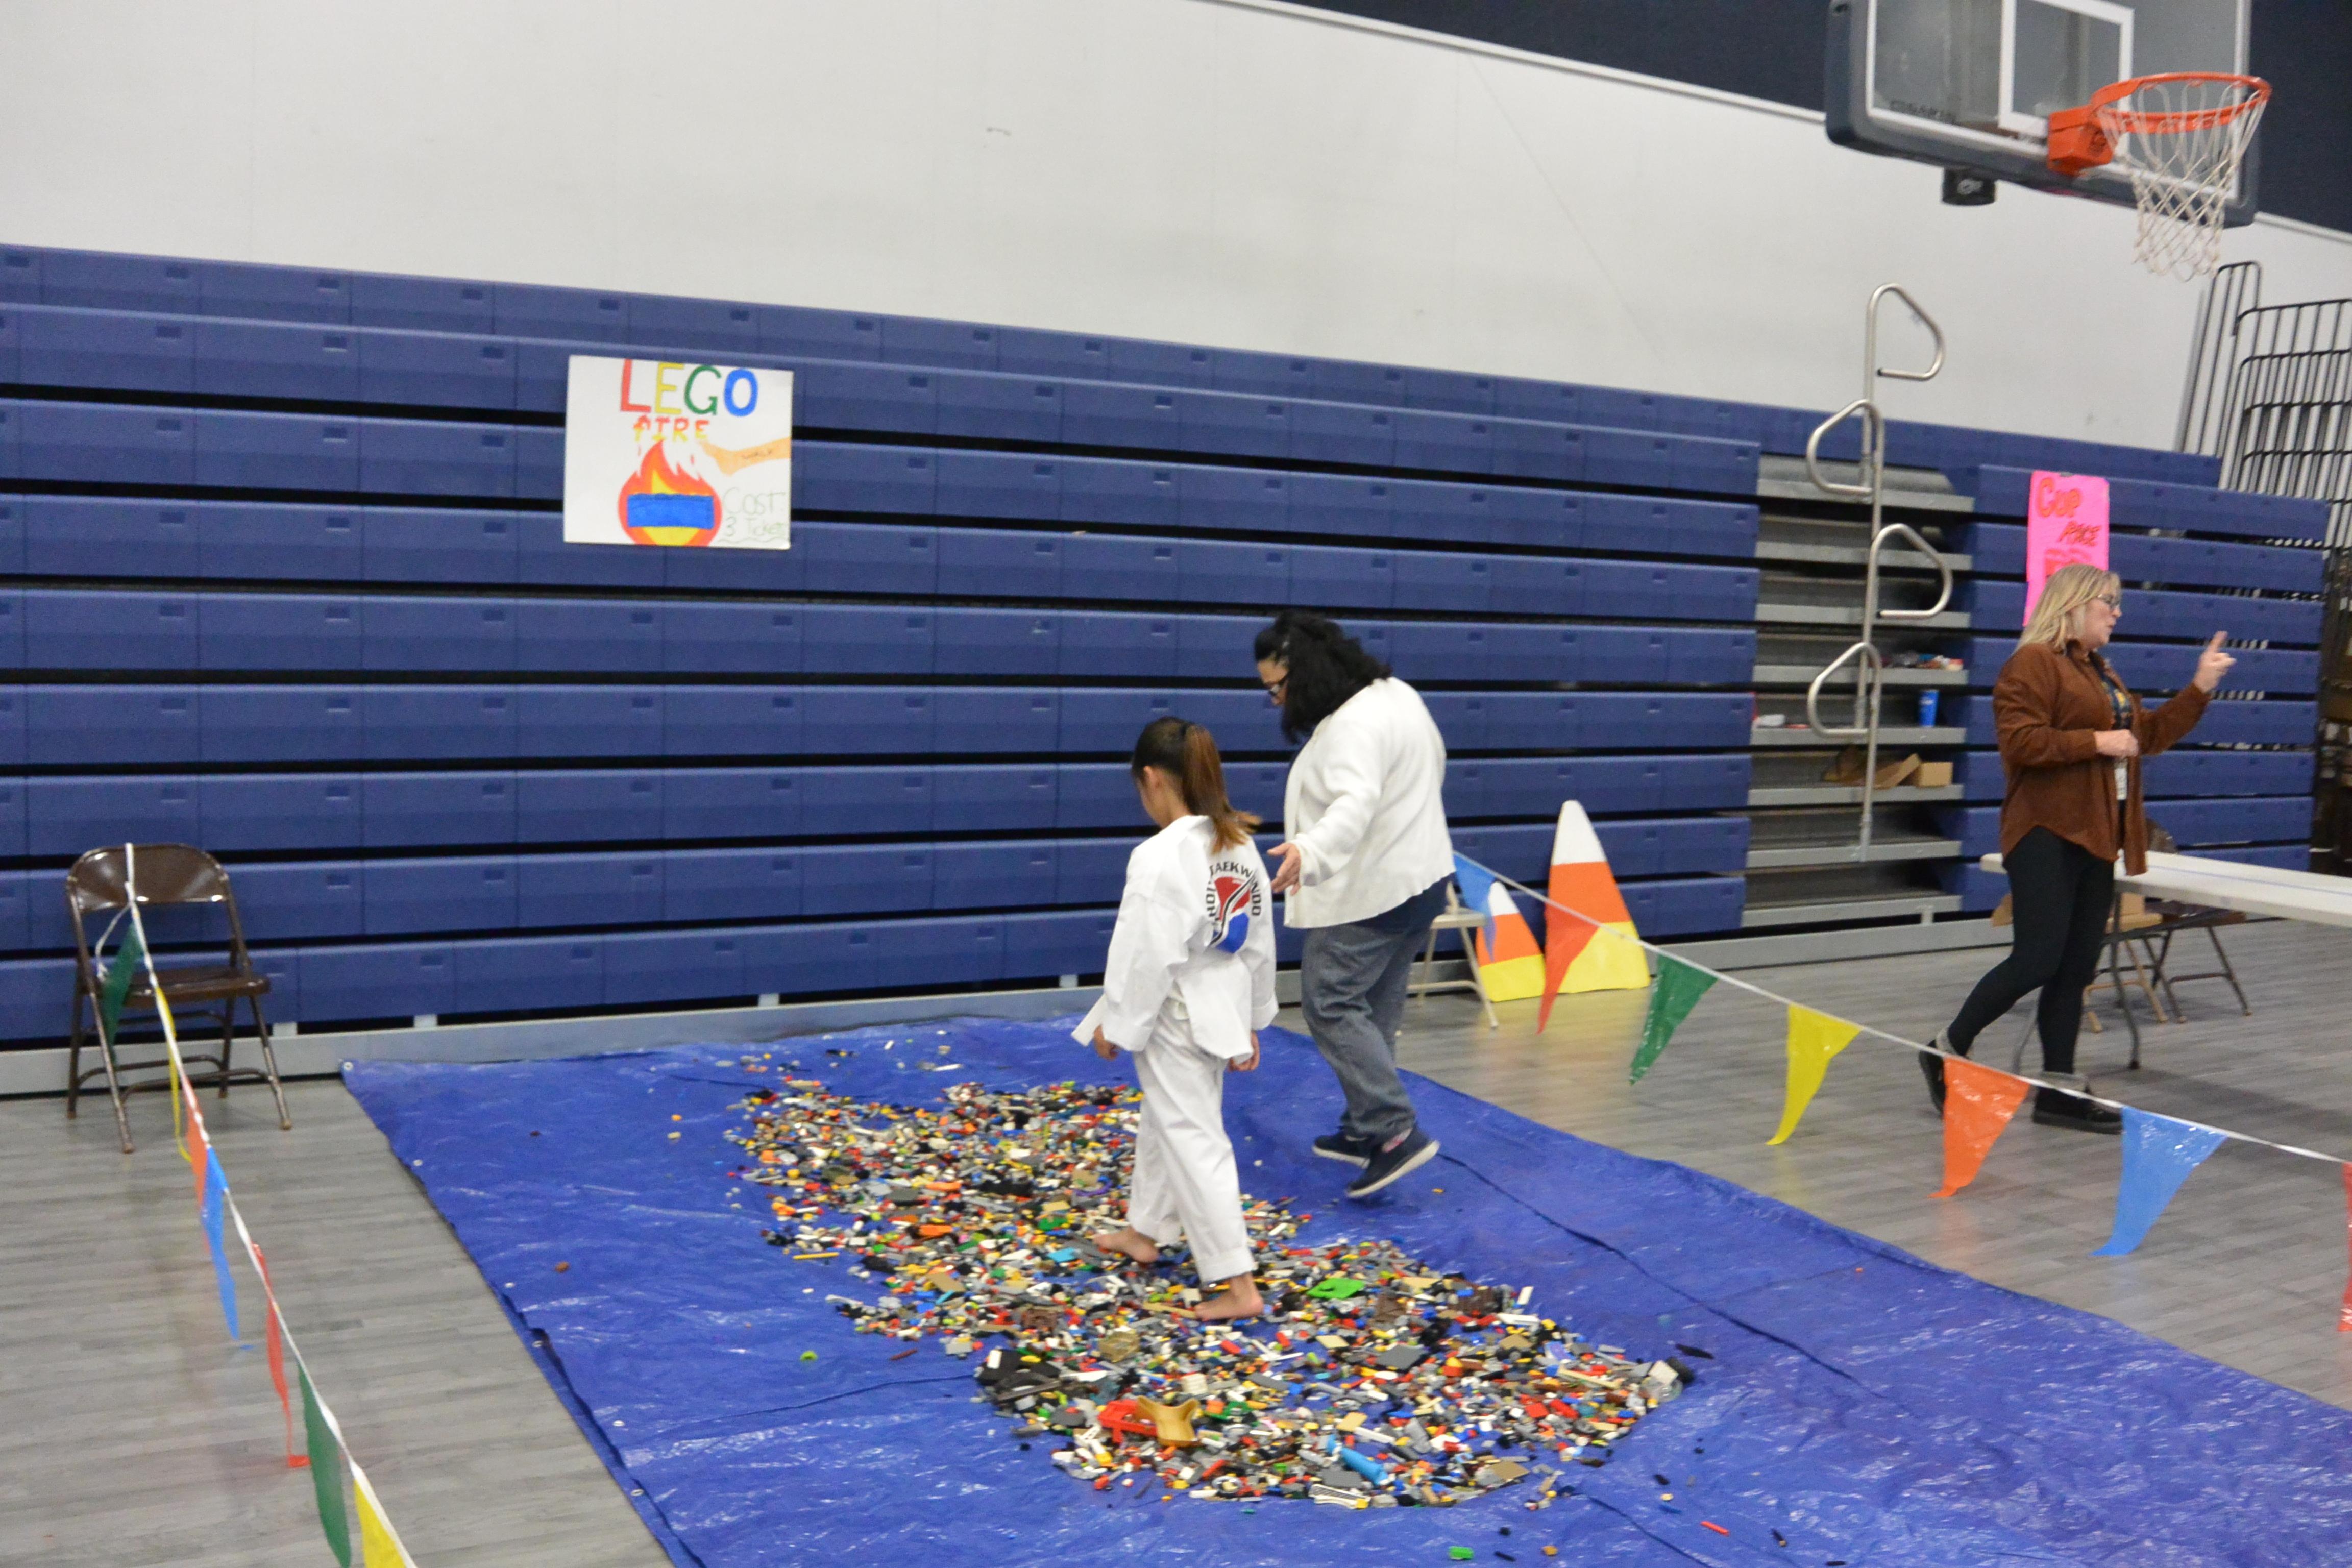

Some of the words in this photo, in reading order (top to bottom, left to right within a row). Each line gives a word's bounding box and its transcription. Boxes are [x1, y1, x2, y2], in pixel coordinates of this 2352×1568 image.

[620, 359, 758, 416] LEGO
[725, 516, 736, 536] 3
[1209, 861, 1261, 916] TAEKWNDO
